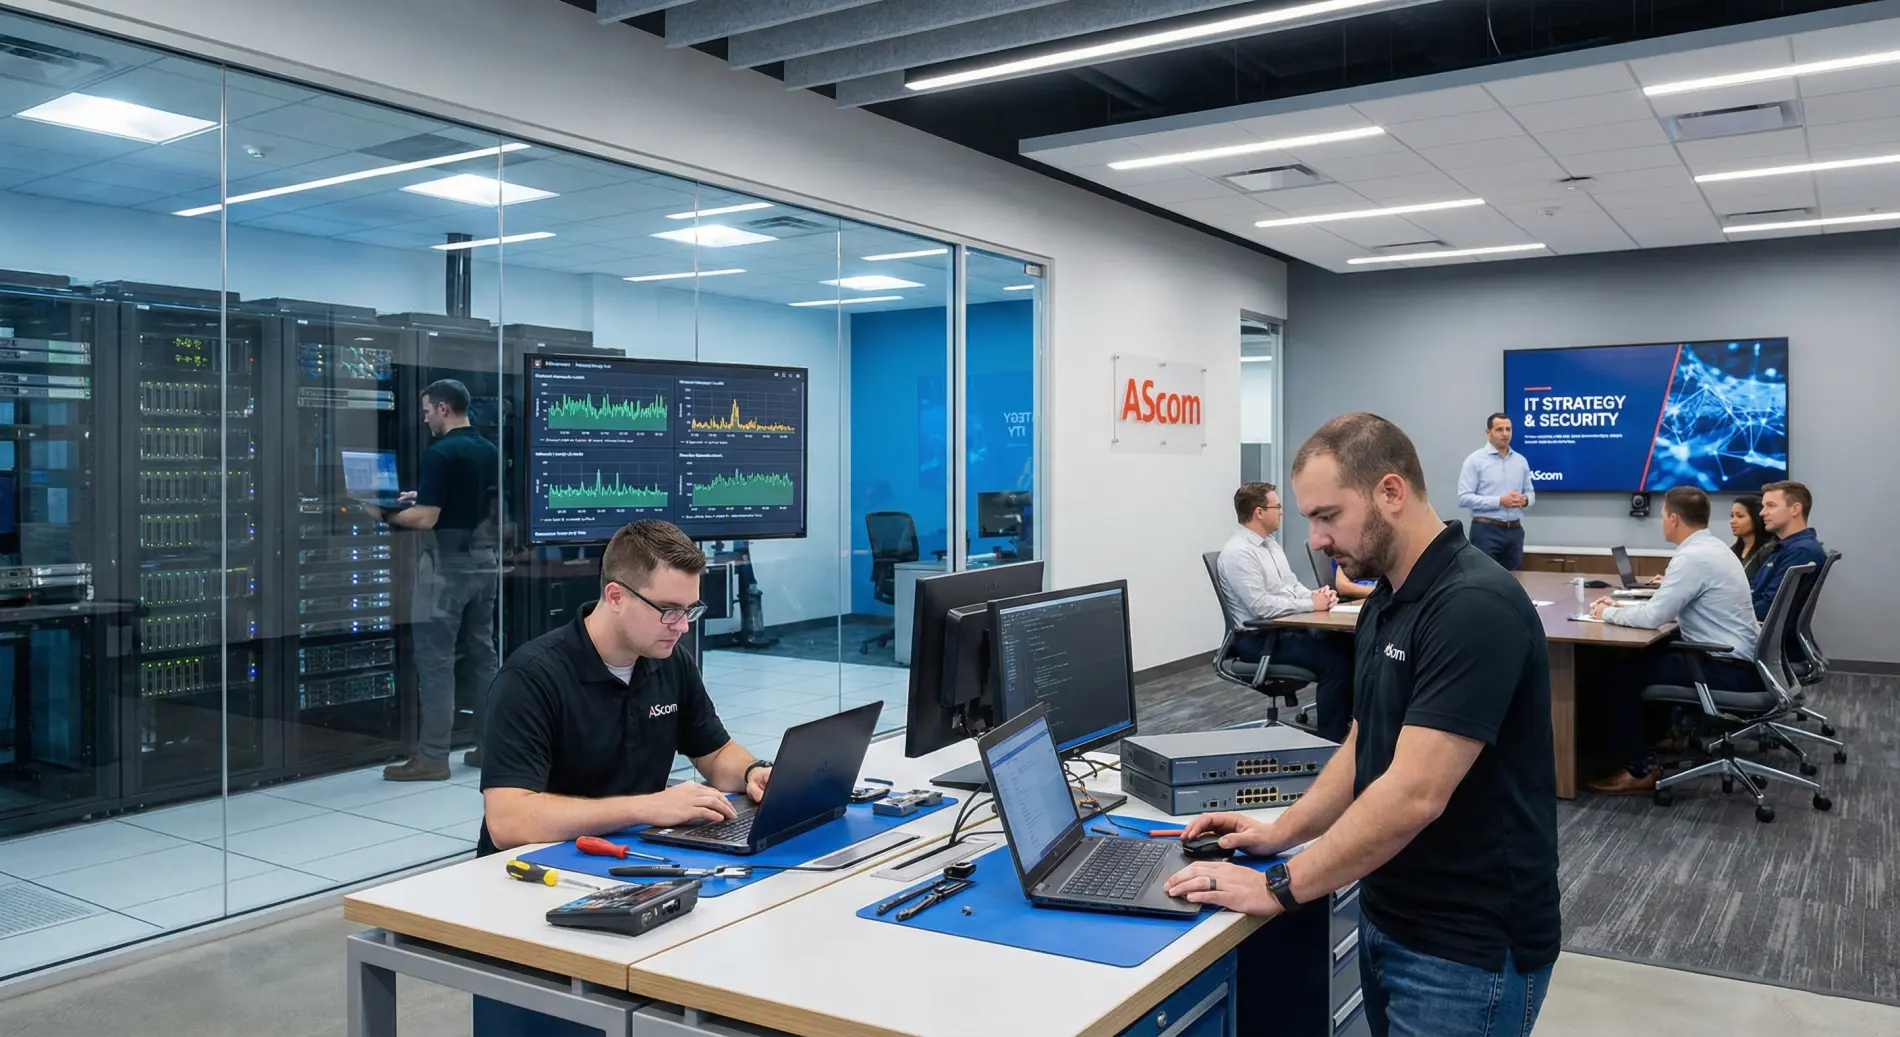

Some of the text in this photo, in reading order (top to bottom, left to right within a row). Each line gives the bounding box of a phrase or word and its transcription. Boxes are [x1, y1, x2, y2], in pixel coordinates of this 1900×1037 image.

[1121, 377, 1201, 425] AScom
[1524, 395, 1626, 411] IT STRATEGY
[1524, 412, 1619, 427] & SECURITY
[648, 703, 678, 719] AScom
